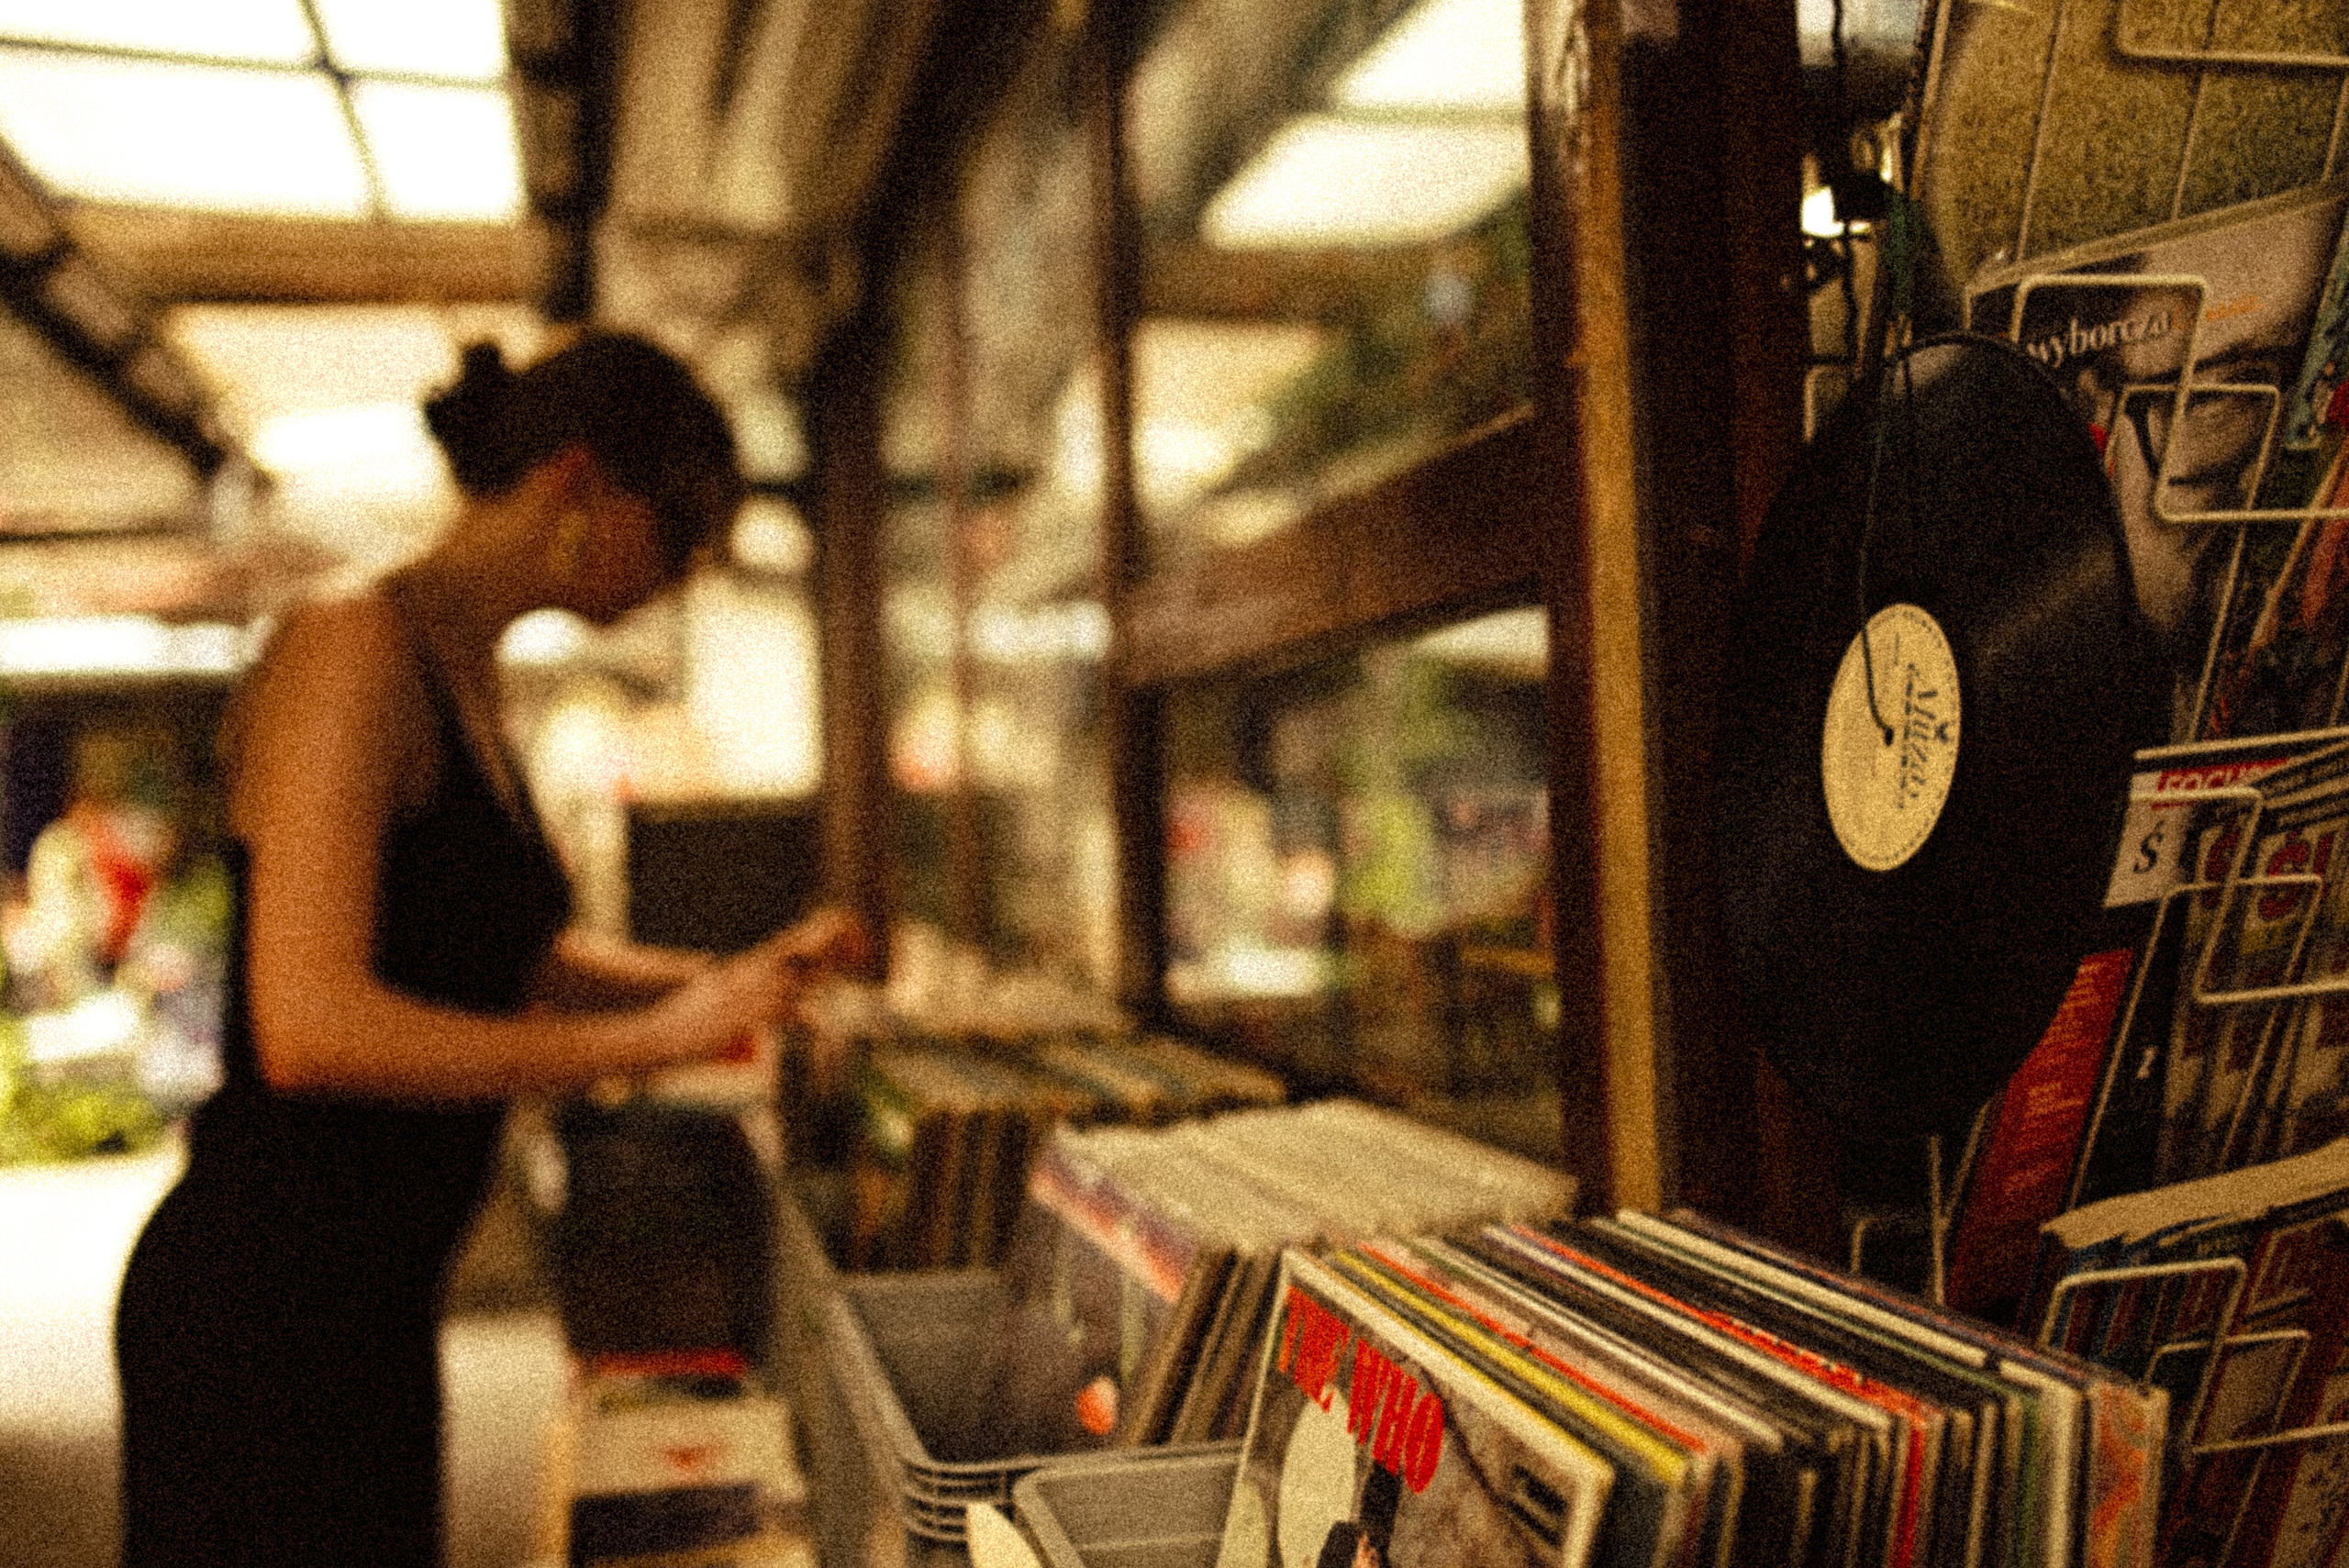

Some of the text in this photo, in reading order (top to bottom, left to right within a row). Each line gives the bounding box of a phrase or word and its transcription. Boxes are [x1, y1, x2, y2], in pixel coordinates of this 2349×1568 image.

[2026, 311, 2171, 369] wyborcza
[1276, 1284, 1445, 1495] THE WHO
